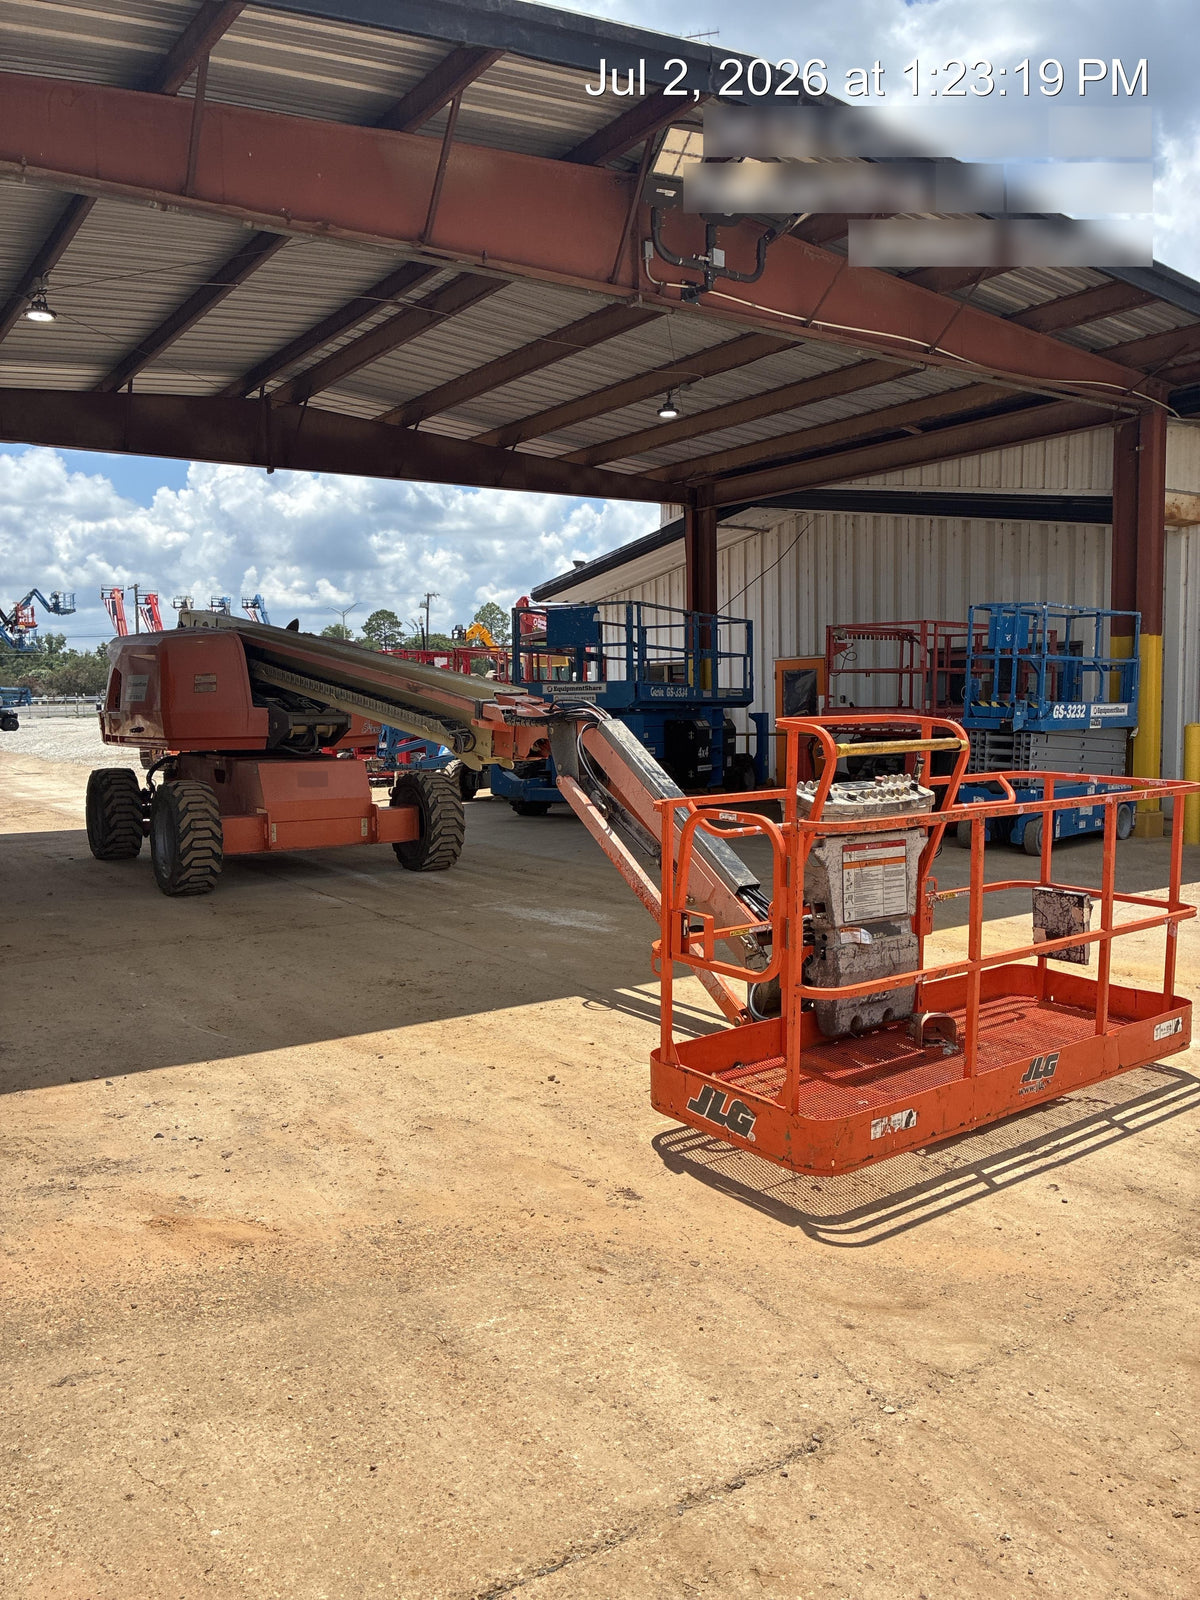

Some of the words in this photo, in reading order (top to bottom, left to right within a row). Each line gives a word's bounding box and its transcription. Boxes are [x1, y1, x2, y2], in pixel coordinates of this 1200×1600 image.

[553, 684, 603, 693] EquipmentShare
[650, 687, 664, 697] Genie
[1053, 704, 1086, 719] GS-3232
[697, 745, 709, 759] 4x4
[1020, 1052, 1061, 1084] JLG
[686, 1083, 757, 1140] JLG
